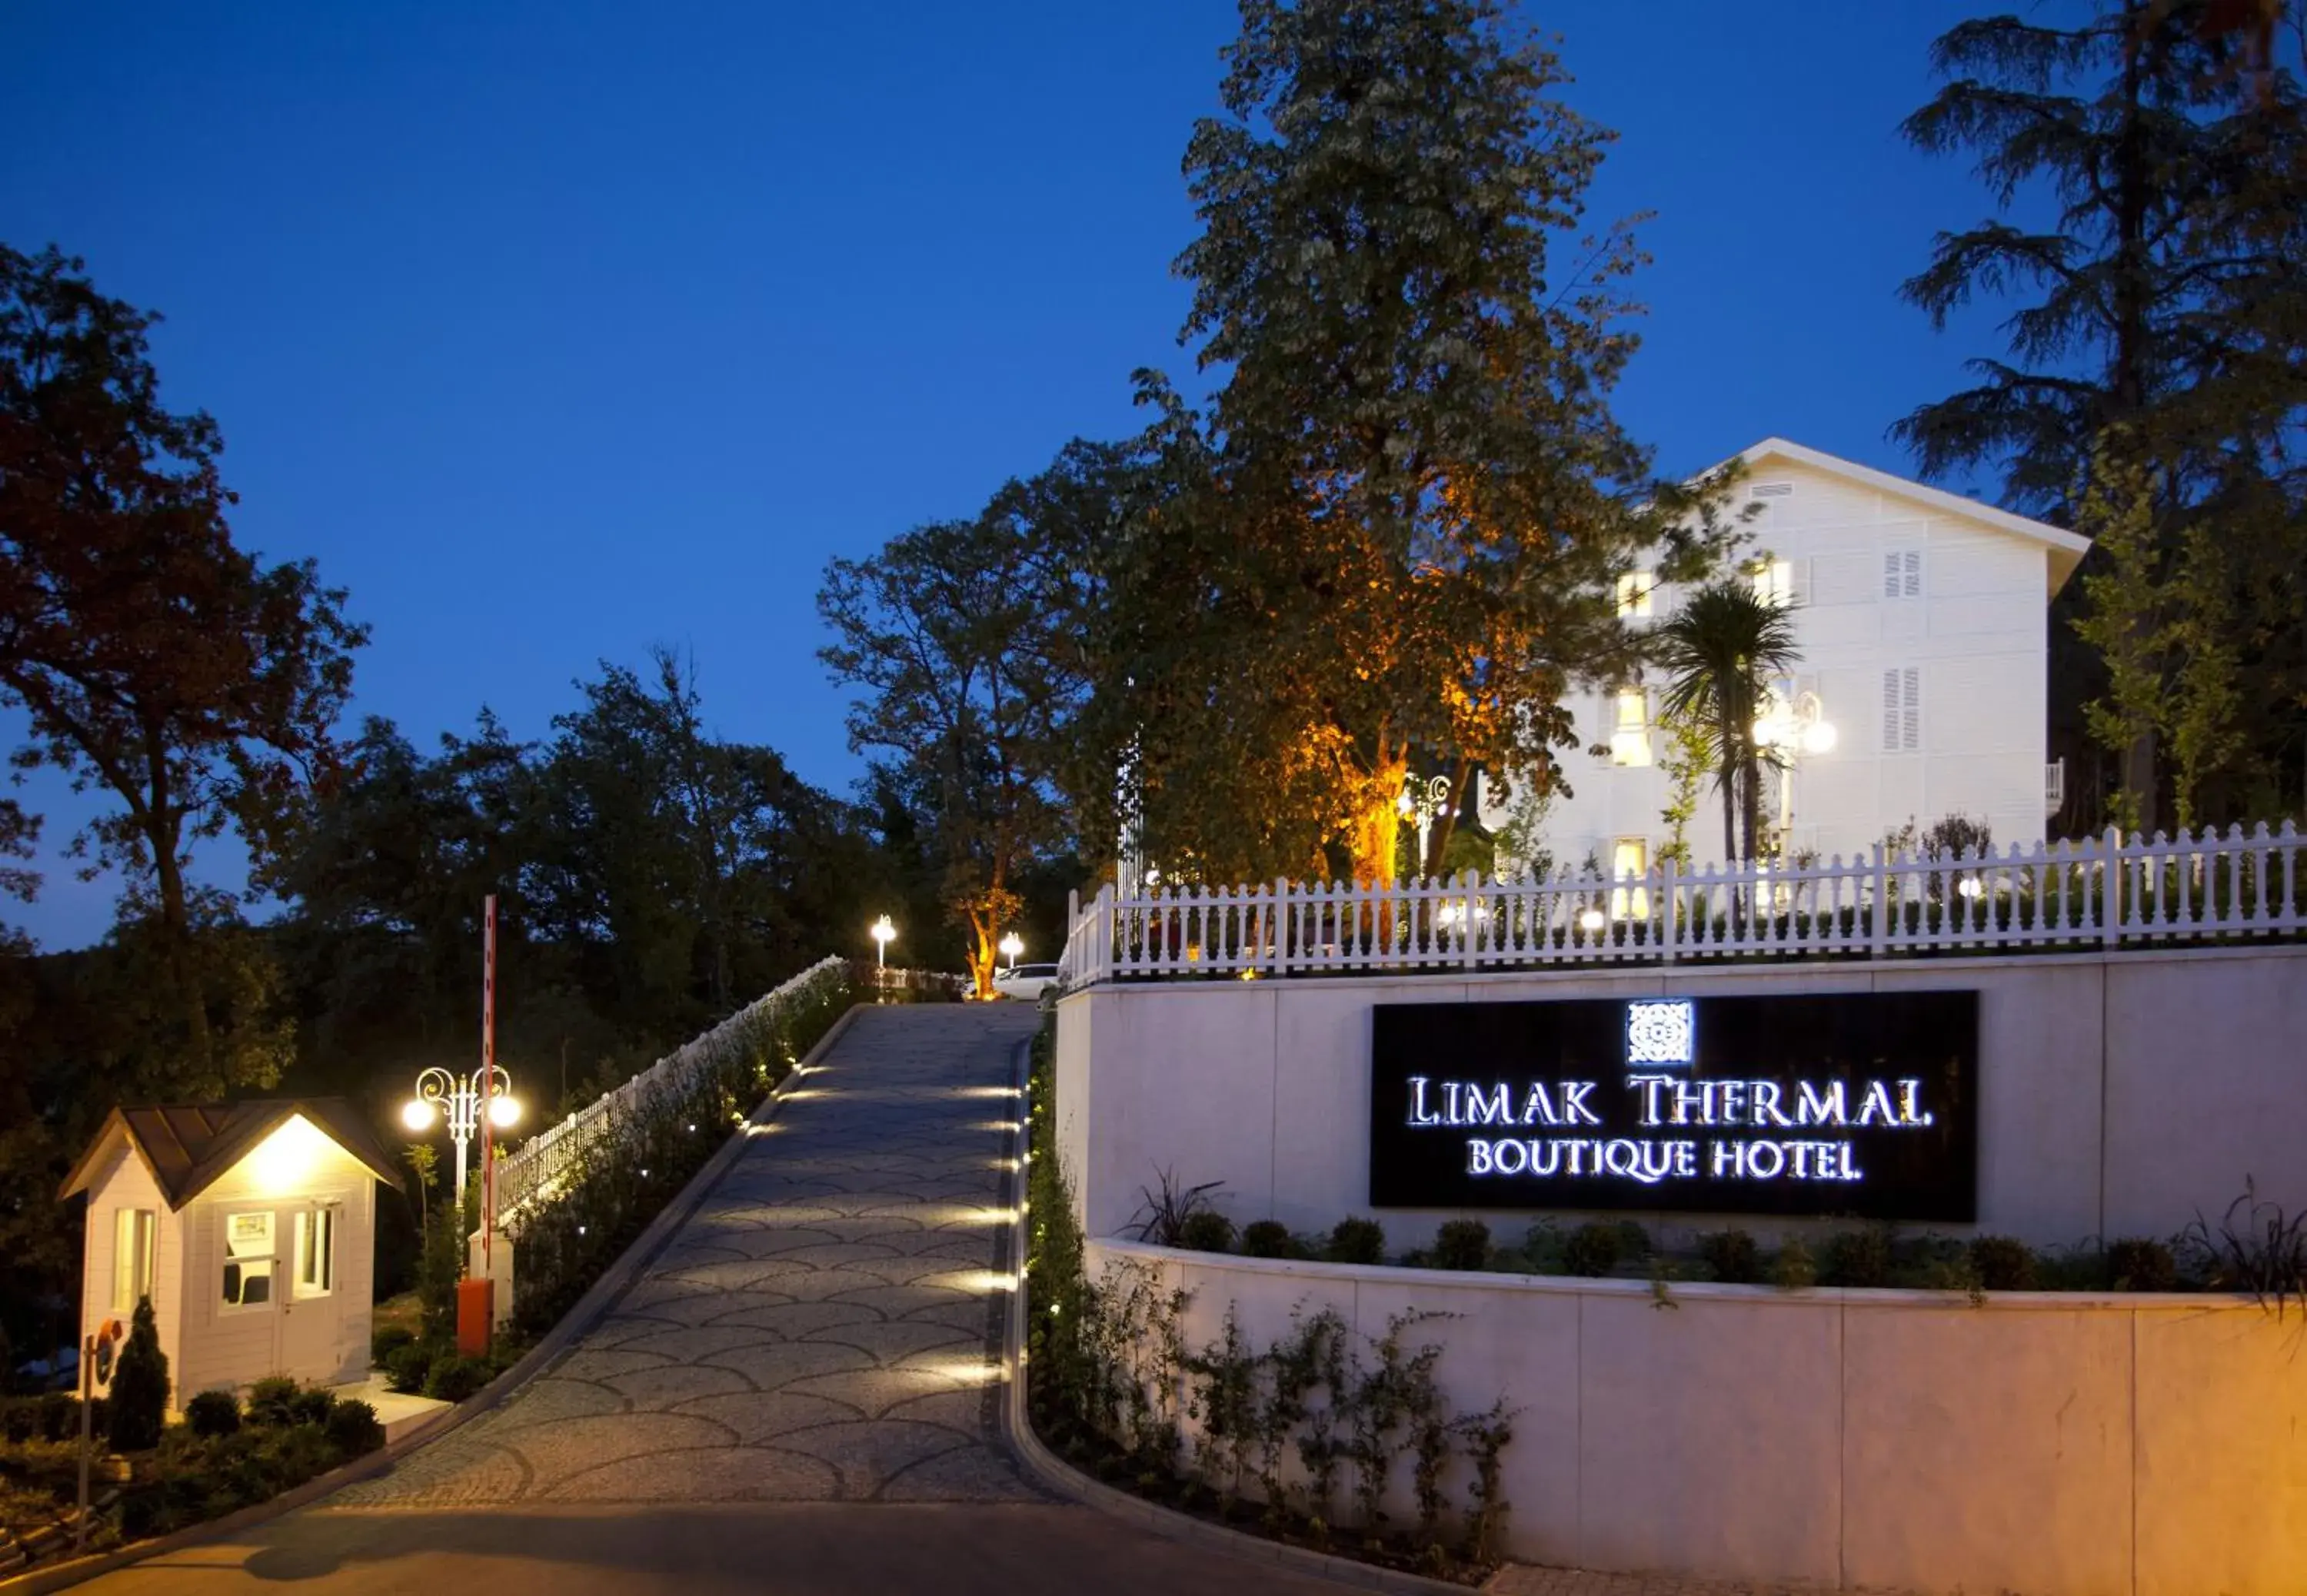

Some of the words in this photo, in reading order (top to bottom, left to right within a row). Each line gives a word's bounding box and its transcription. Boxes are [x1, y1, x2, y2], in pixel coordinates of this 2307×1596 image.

[1406, 1076, 1601, 1125] LIMAK
[1626, 1074, 1932, 1126] THERMAL
[1466, 1139, 1696, 1183] BOUTIQUE
[1711, 1139, 1862, 1179] HOTEL
